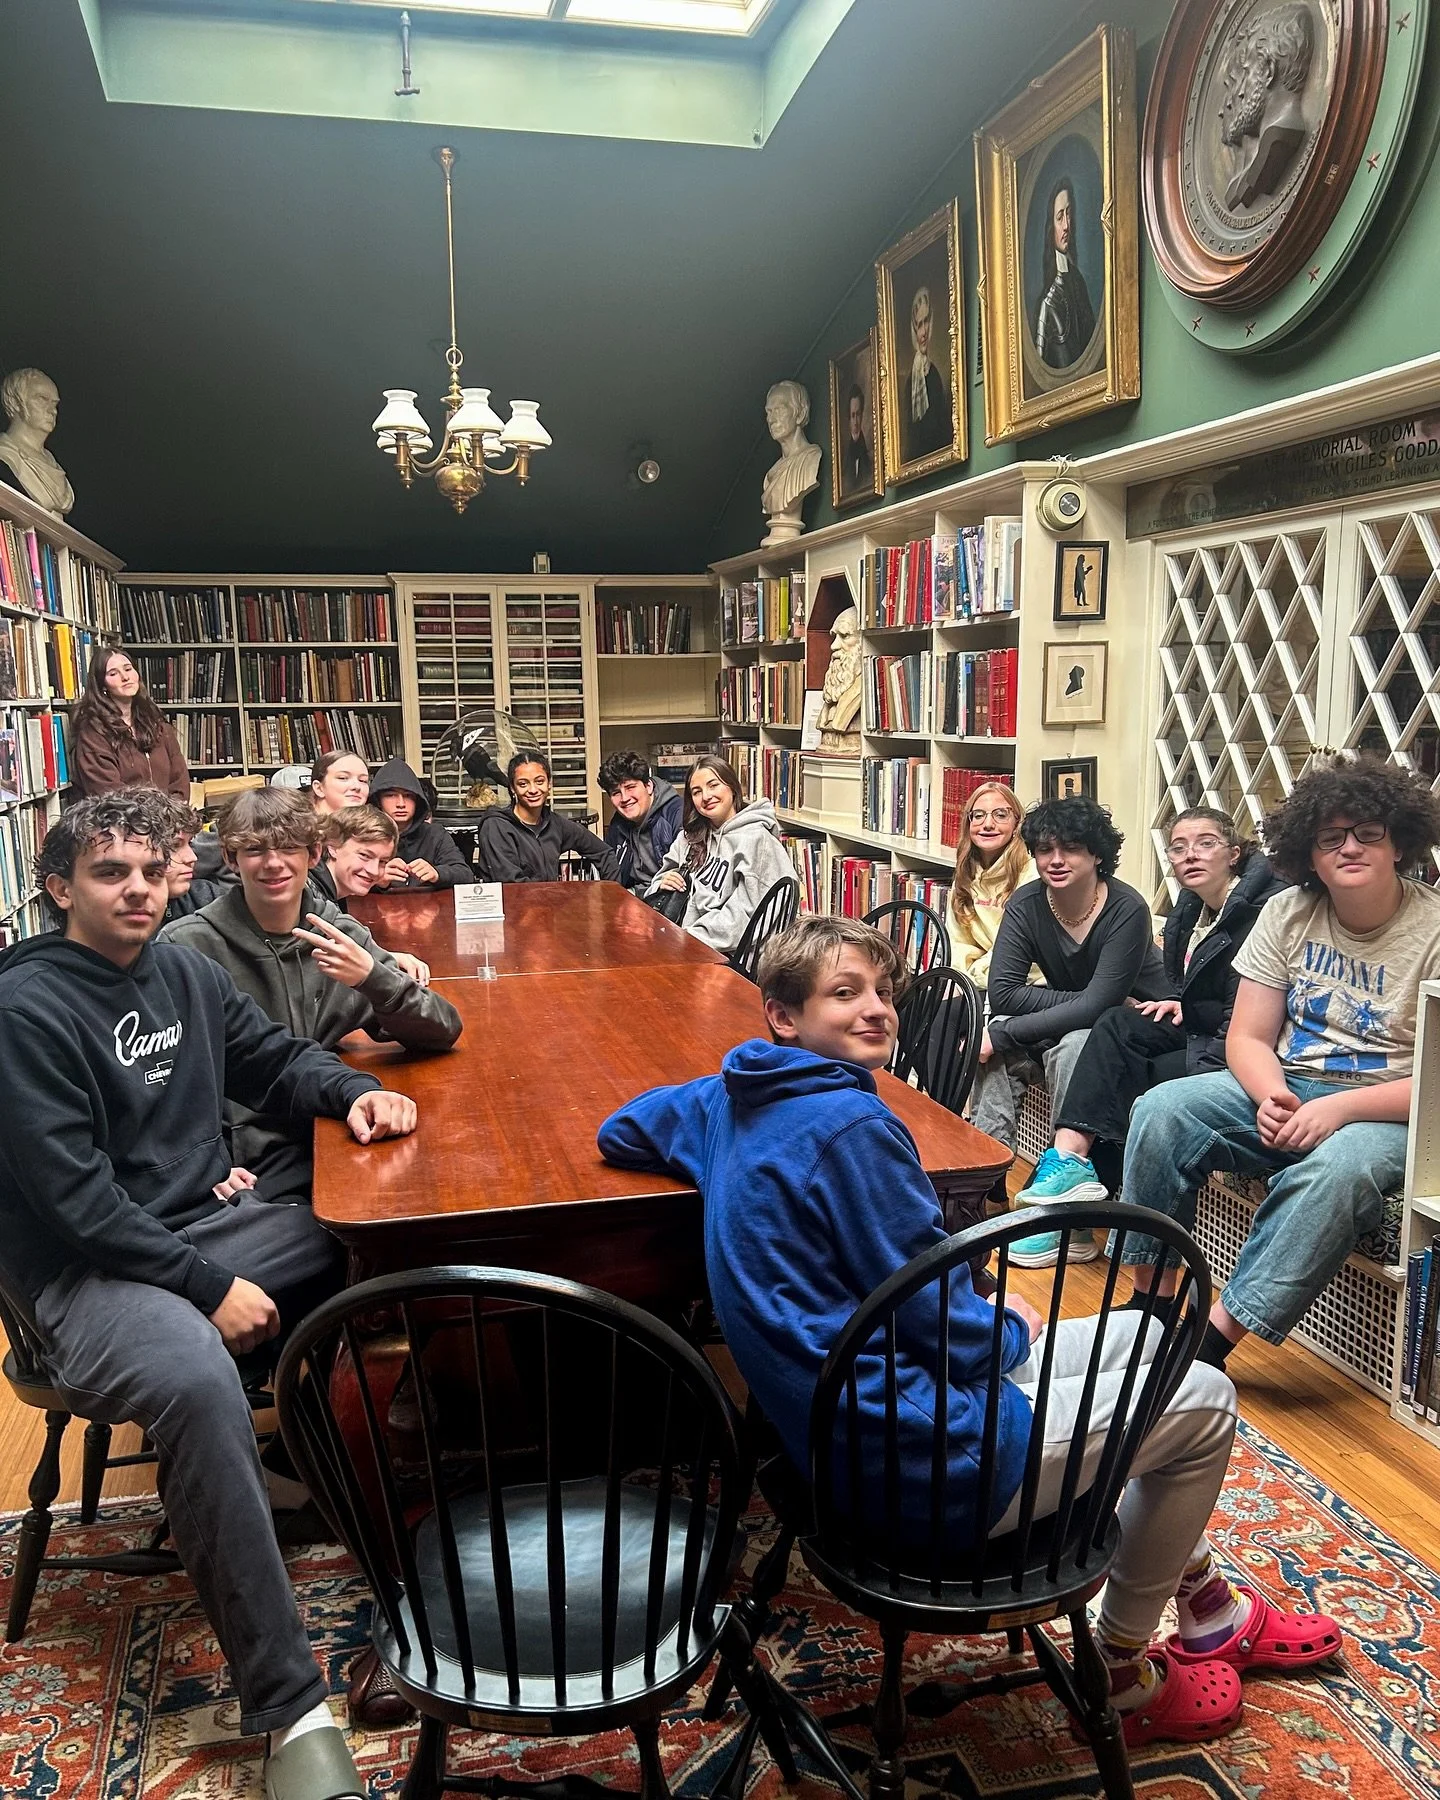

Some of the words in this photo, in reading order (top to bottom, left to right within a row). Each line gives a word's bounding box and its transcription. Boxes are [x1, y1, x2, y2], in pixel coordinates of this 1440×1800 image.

[1369, 420, 1416, 447] ROOM
[1345, 450, 1387, 475] GILES
[1385, 463, 1429, 482] LEARNING
[148, 1068, 172, 1080] CHEVR
[1417, 1285, 1428, 1328] GARDENS
[1412, 1343, 1421, 1380] DELIGHT
